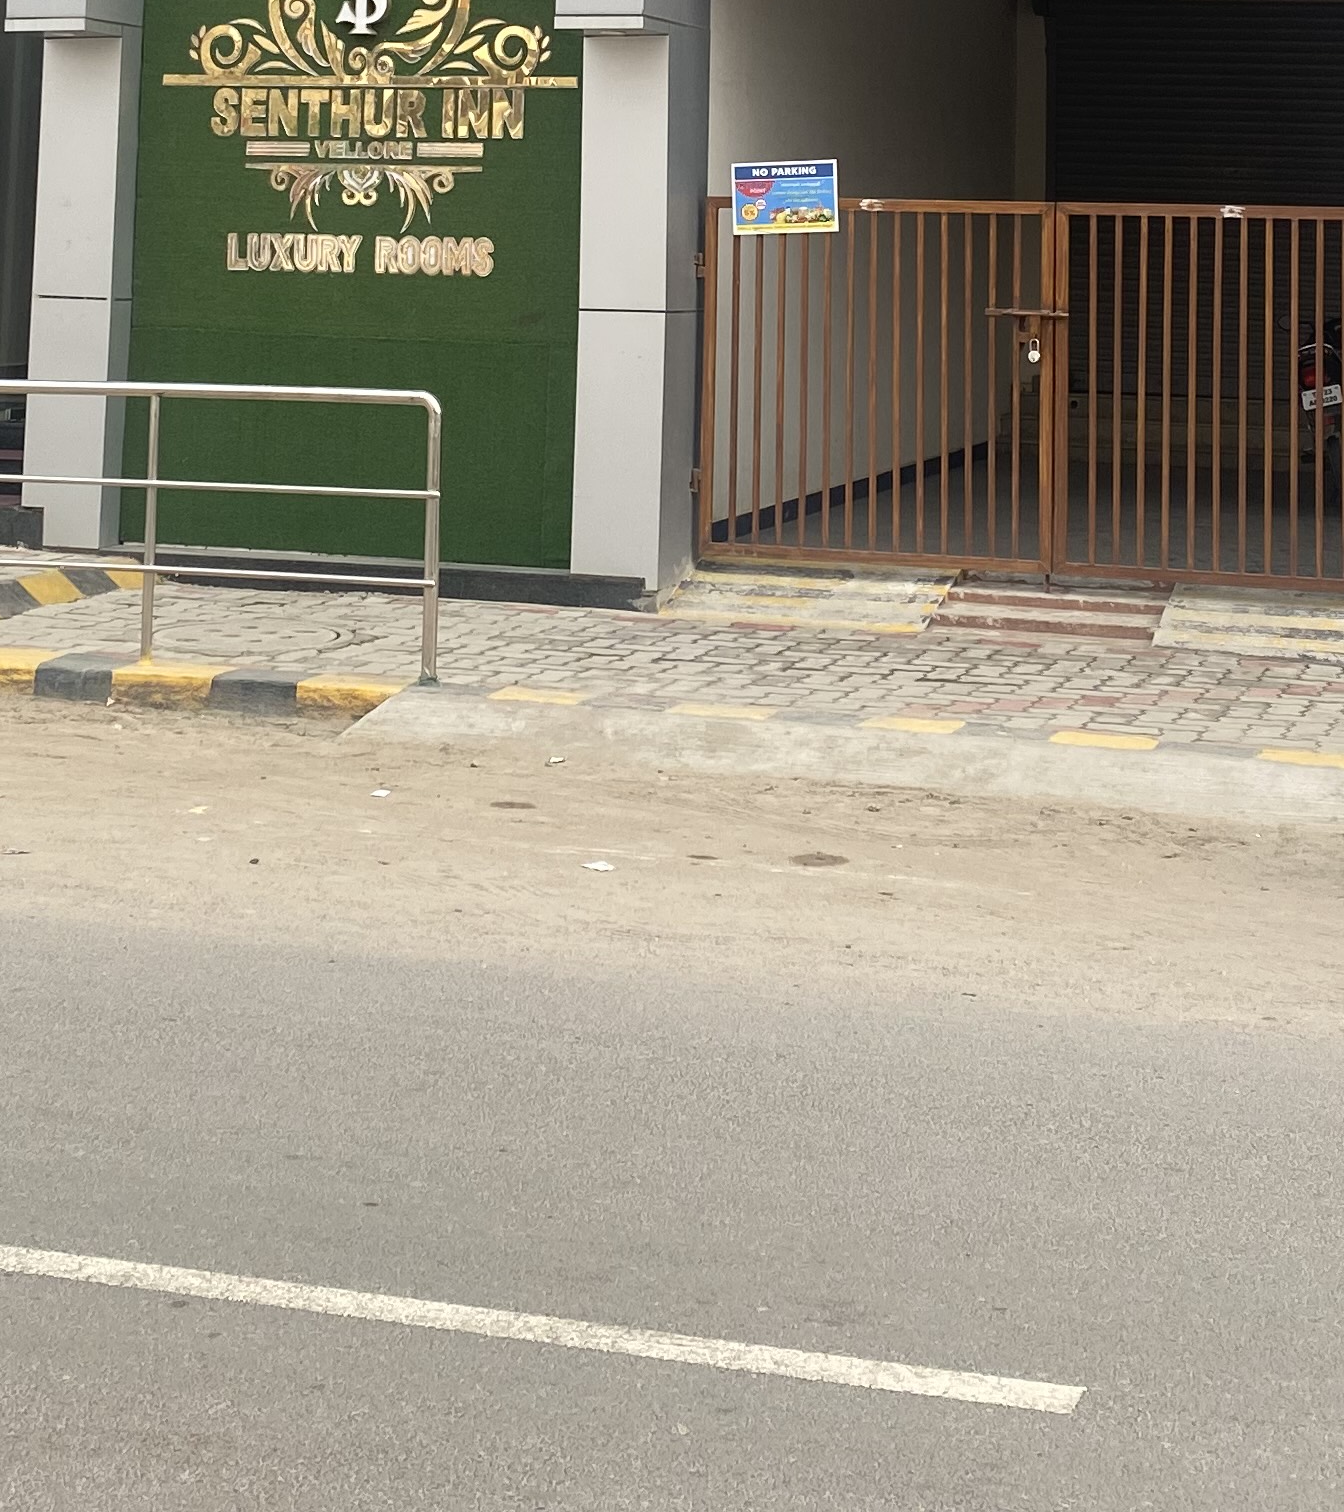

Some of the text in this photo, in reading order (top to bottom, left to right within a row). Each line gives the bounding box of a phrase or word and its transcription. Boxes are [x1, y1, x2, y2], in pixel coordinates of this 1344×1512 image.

[210, 87, 526, 140] SENTHUR INN
[313, 140, 413, 160] VELLORE
[751, 166, 817, 177] NO PARKING
[226, 232, 495, 277] LUXURY ROOMS
